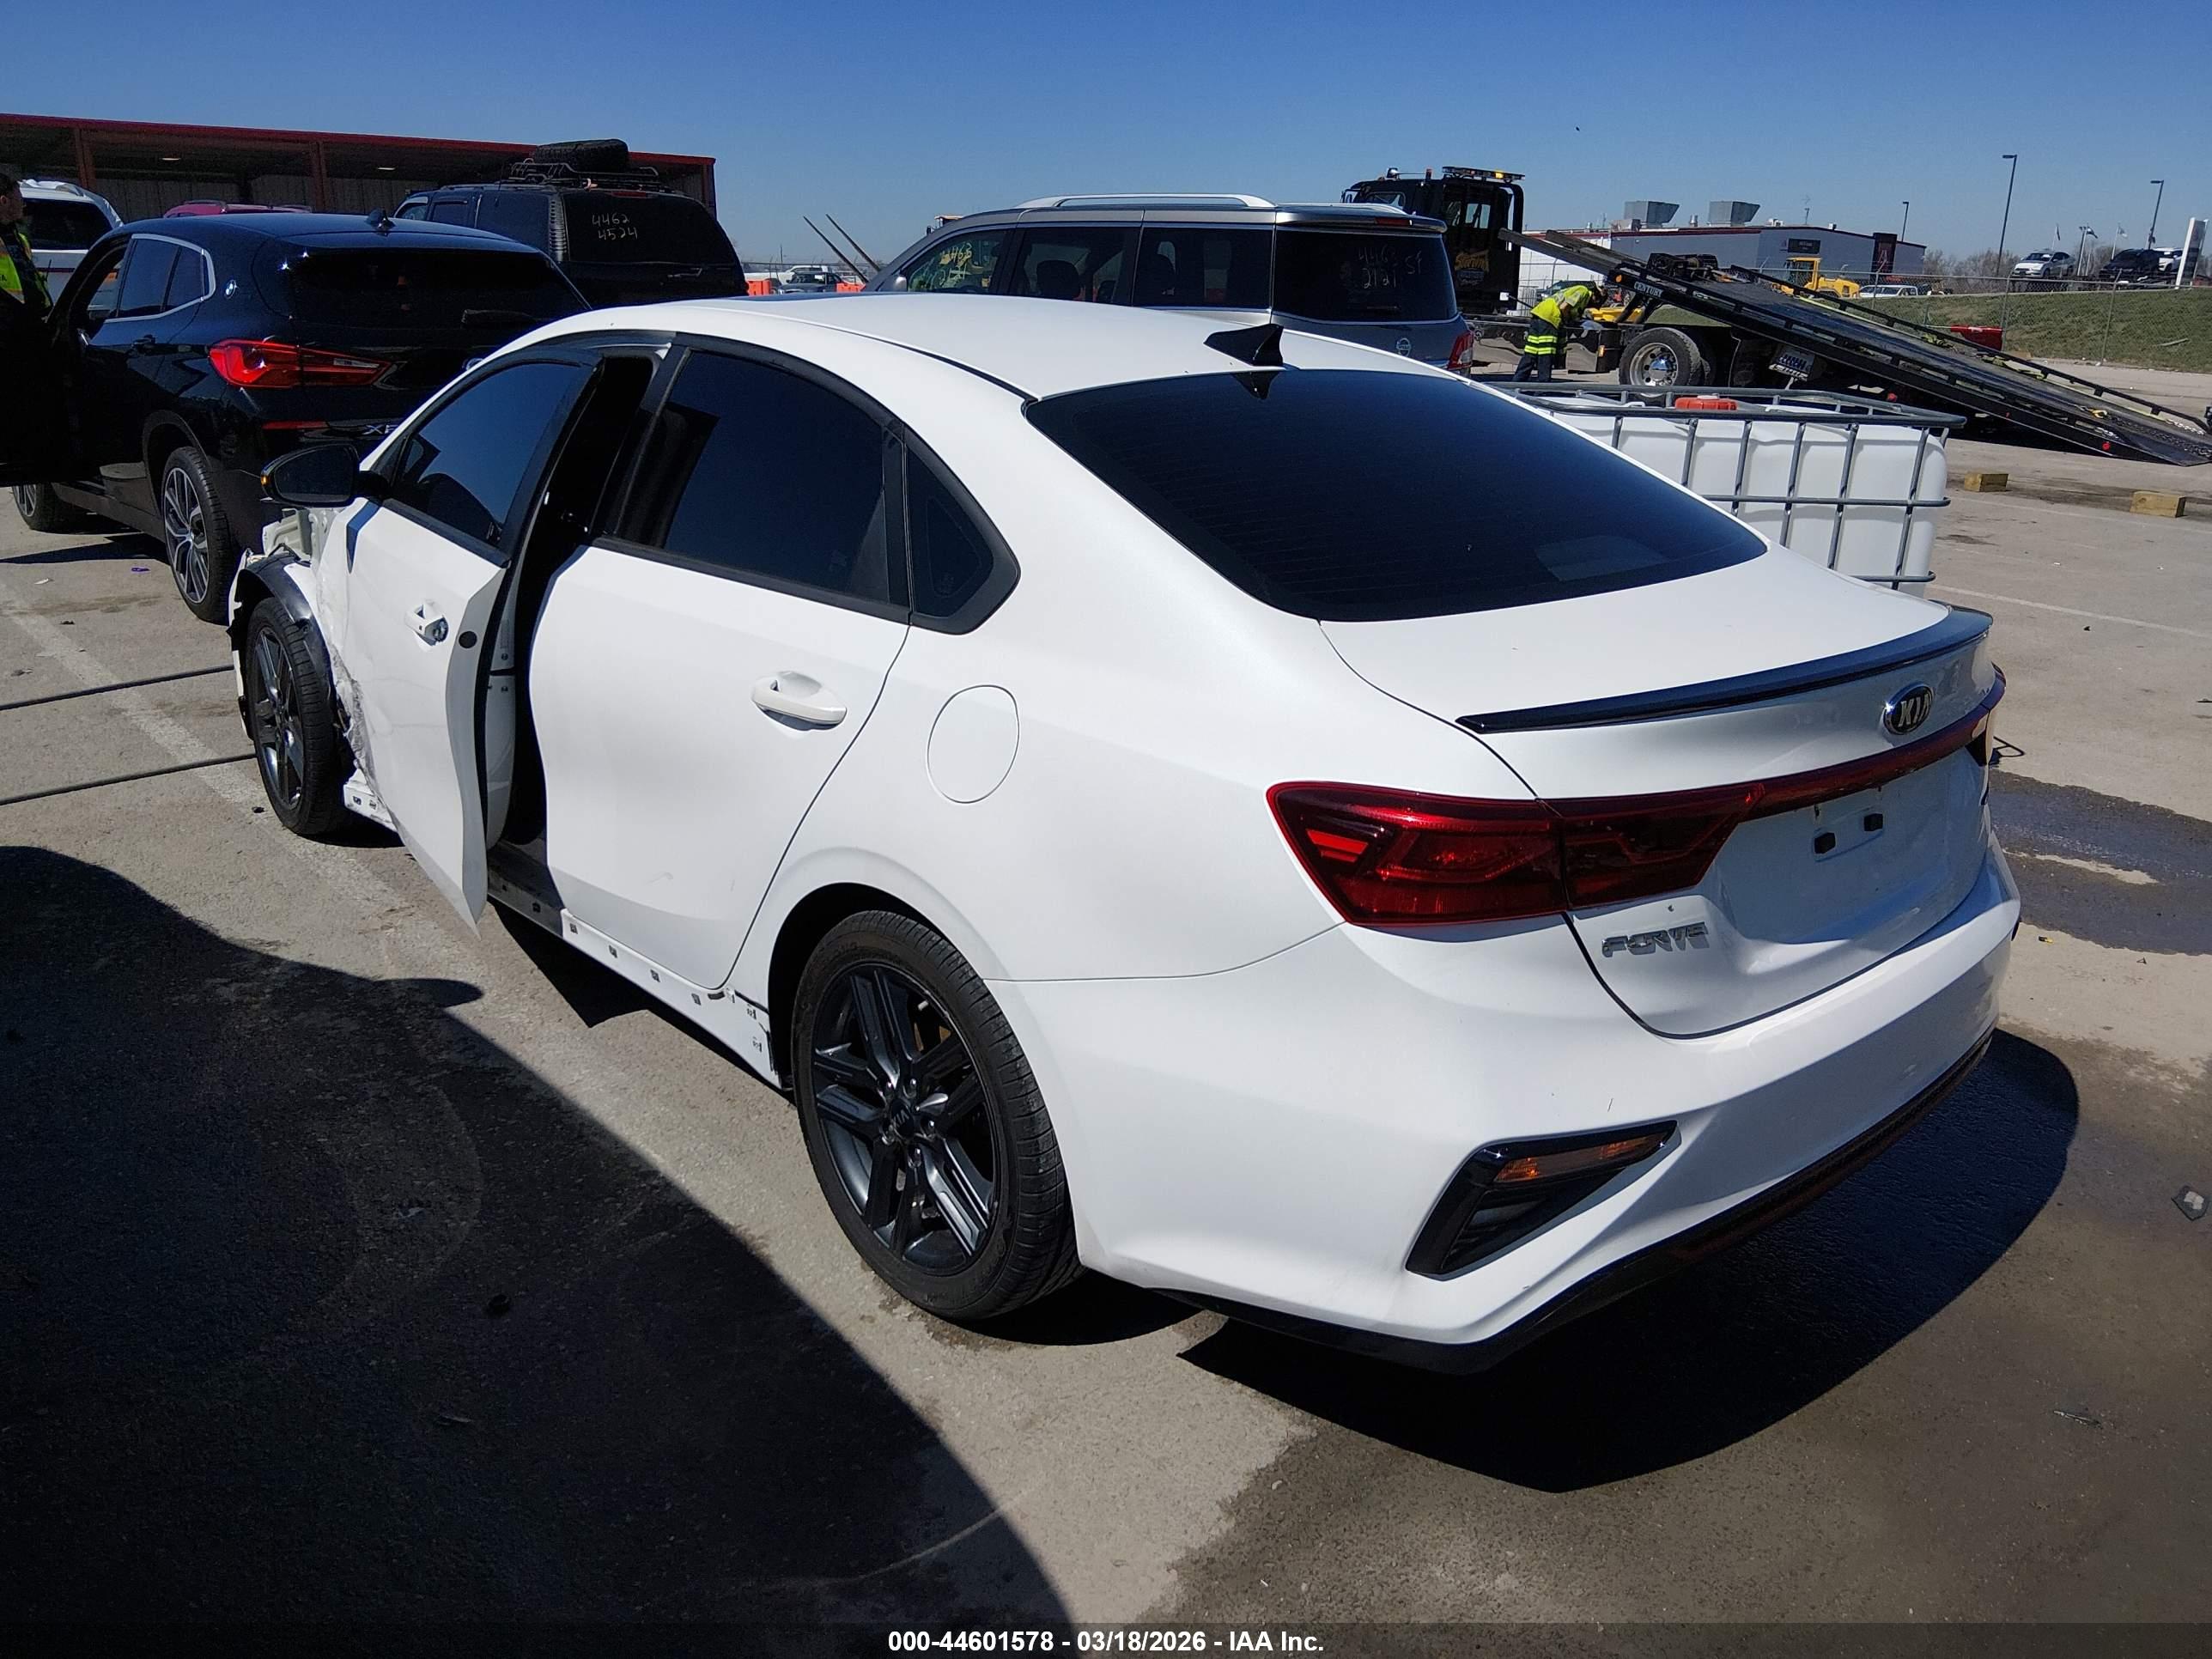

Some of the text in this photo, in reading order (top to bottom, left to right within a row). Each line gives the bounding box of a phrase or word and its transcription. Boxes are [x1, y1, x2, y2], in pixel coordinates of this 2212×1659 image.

[592, 212, 629, 227] 4462
[598, 227, 638, 240] 4524
[1634, 281, 1663, 297] CENTURY
[1897, 693, 1930, 727] KIA
[1602, 921, 1710, 957] FORTE
